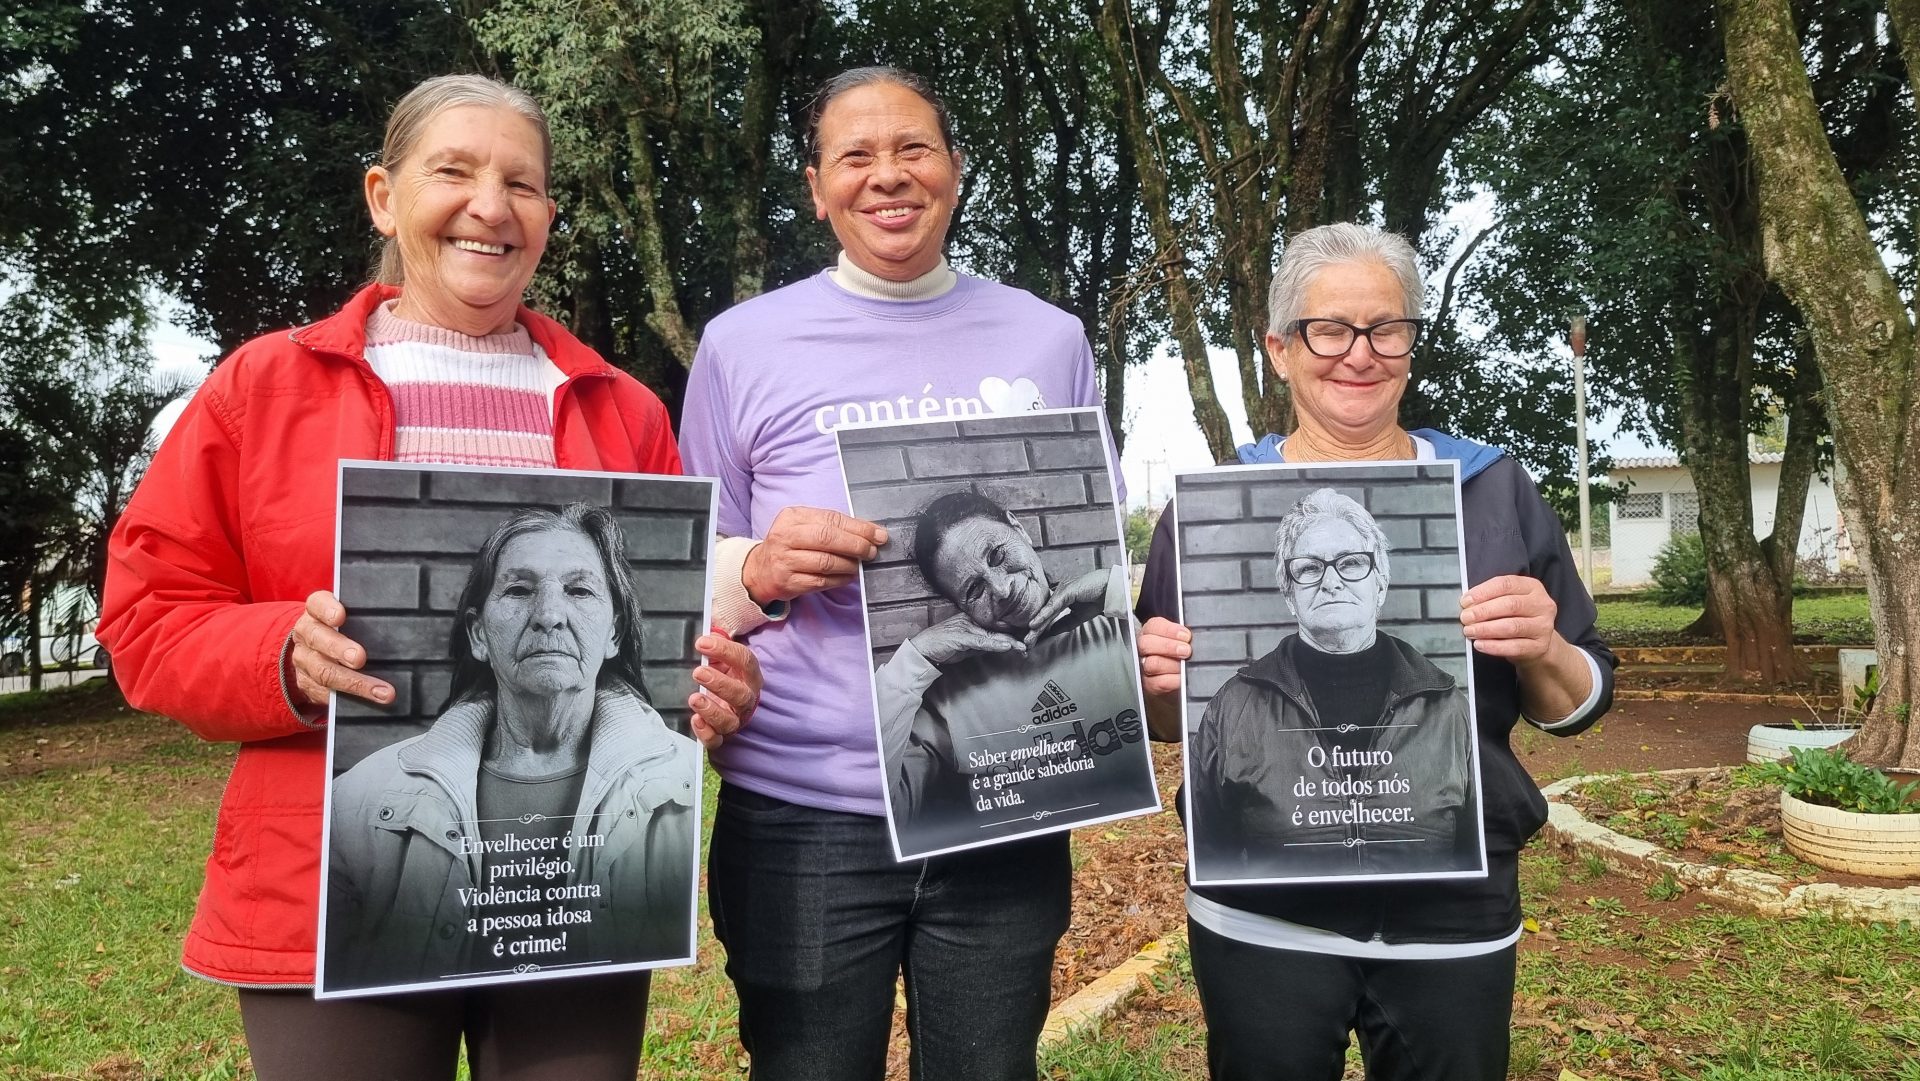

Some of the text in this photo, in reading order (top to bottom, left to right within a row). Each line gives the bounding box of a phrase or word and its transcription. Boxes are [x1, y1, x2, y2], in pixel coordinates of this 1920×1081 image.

[1032, 703, 1078, 725] adidas
[968, 738, 1077, 769] Saber envelhecer
[1307, 745, 1393, 768] O futuro
[972, 755, 1096, 791] é a grande sabedoria
[1293, 772, 1411, 797] de todos nós
[976, 789, 1025, 813] da vida.
[1291, 800, 1415, 826] é envelhecer.
[458, 830, 605, 855] Envelhecer é um
[489, 856, 576, 884] privilégio.
[457, 882, 602, 907] Violência contra
[467, 906, 593, 936] a pessoa idosa
[493, 931, 568, 957] é crime!
